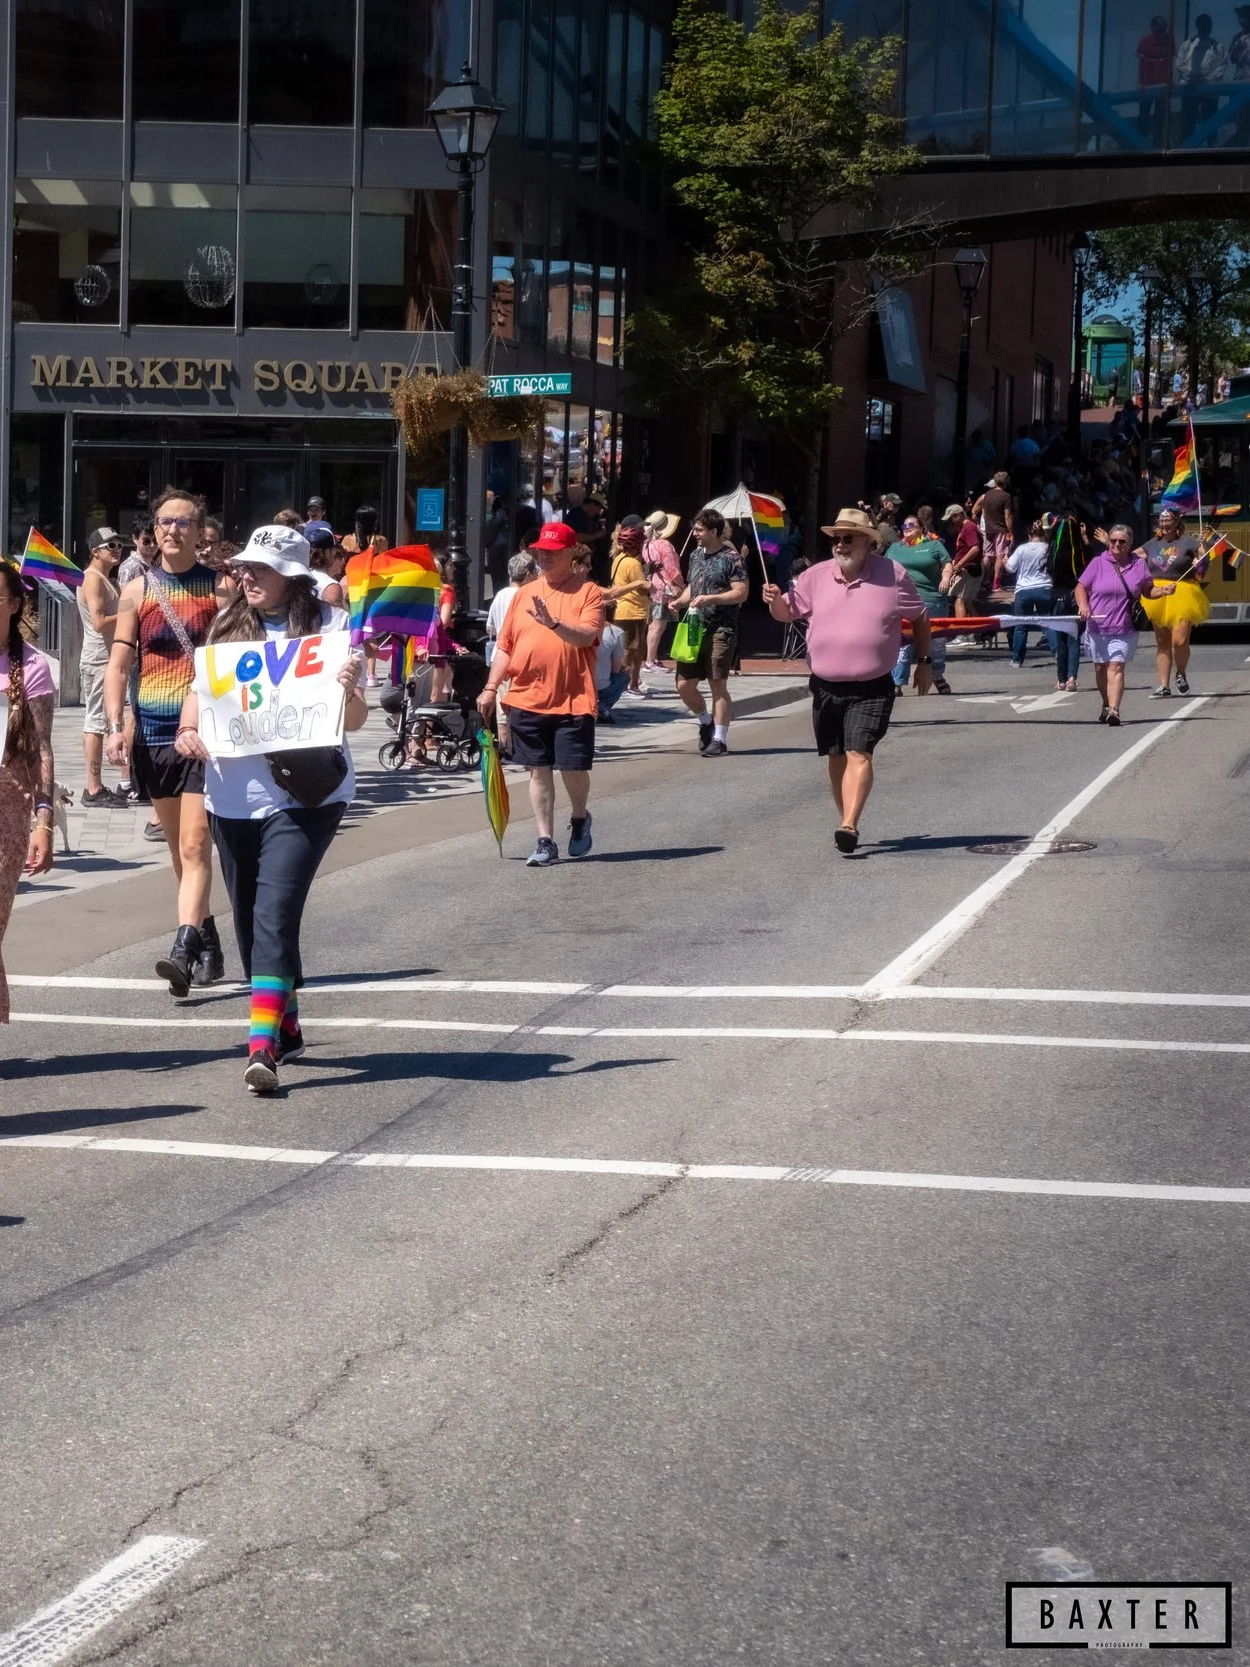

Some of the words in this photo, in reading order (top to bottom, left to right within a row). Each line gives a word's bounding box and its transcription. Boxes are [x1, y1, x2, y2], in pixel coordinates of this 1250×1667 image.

[30, 354, 233, 391] MARKET
[488, 378, 509, 393] PAT
[513, 376, 555, 393] ROCCA
[556, 383, 569, 391] WAY
[206, 636, 324, 700] LOVE
[201, 688, 327, 753] Louder
